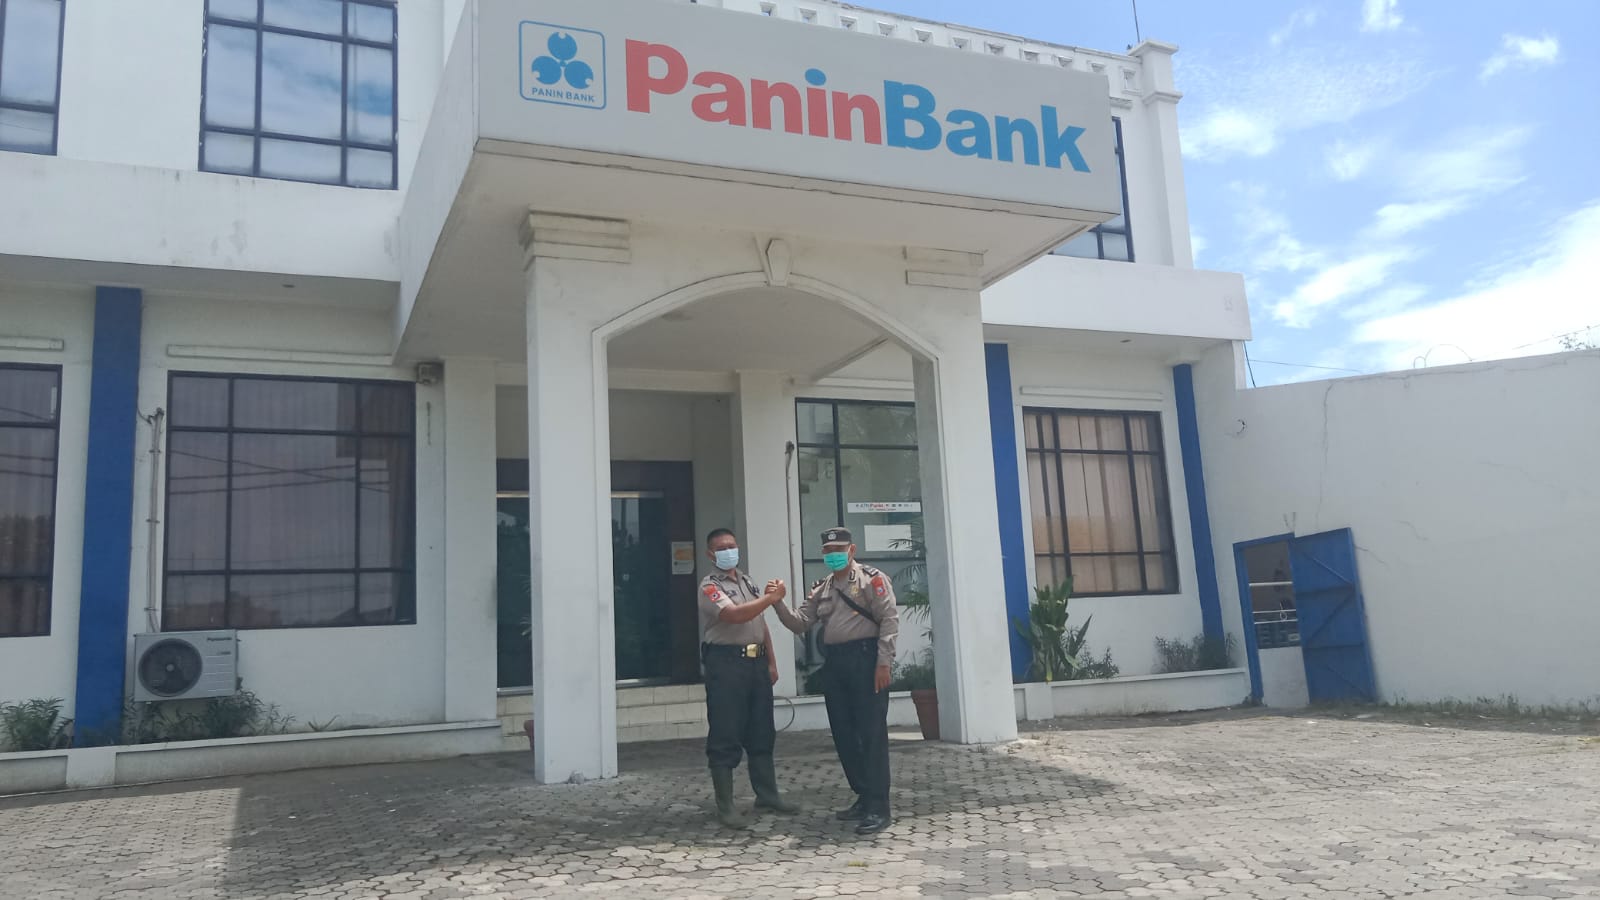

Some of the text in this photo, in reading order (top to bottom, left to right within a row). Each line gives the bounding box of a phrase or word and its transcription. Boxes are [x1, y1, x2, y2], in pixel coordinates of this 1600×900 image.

[531, 87, 595, 102] PANIN BANK
[627, 40, 1090, 173] PaninBank
